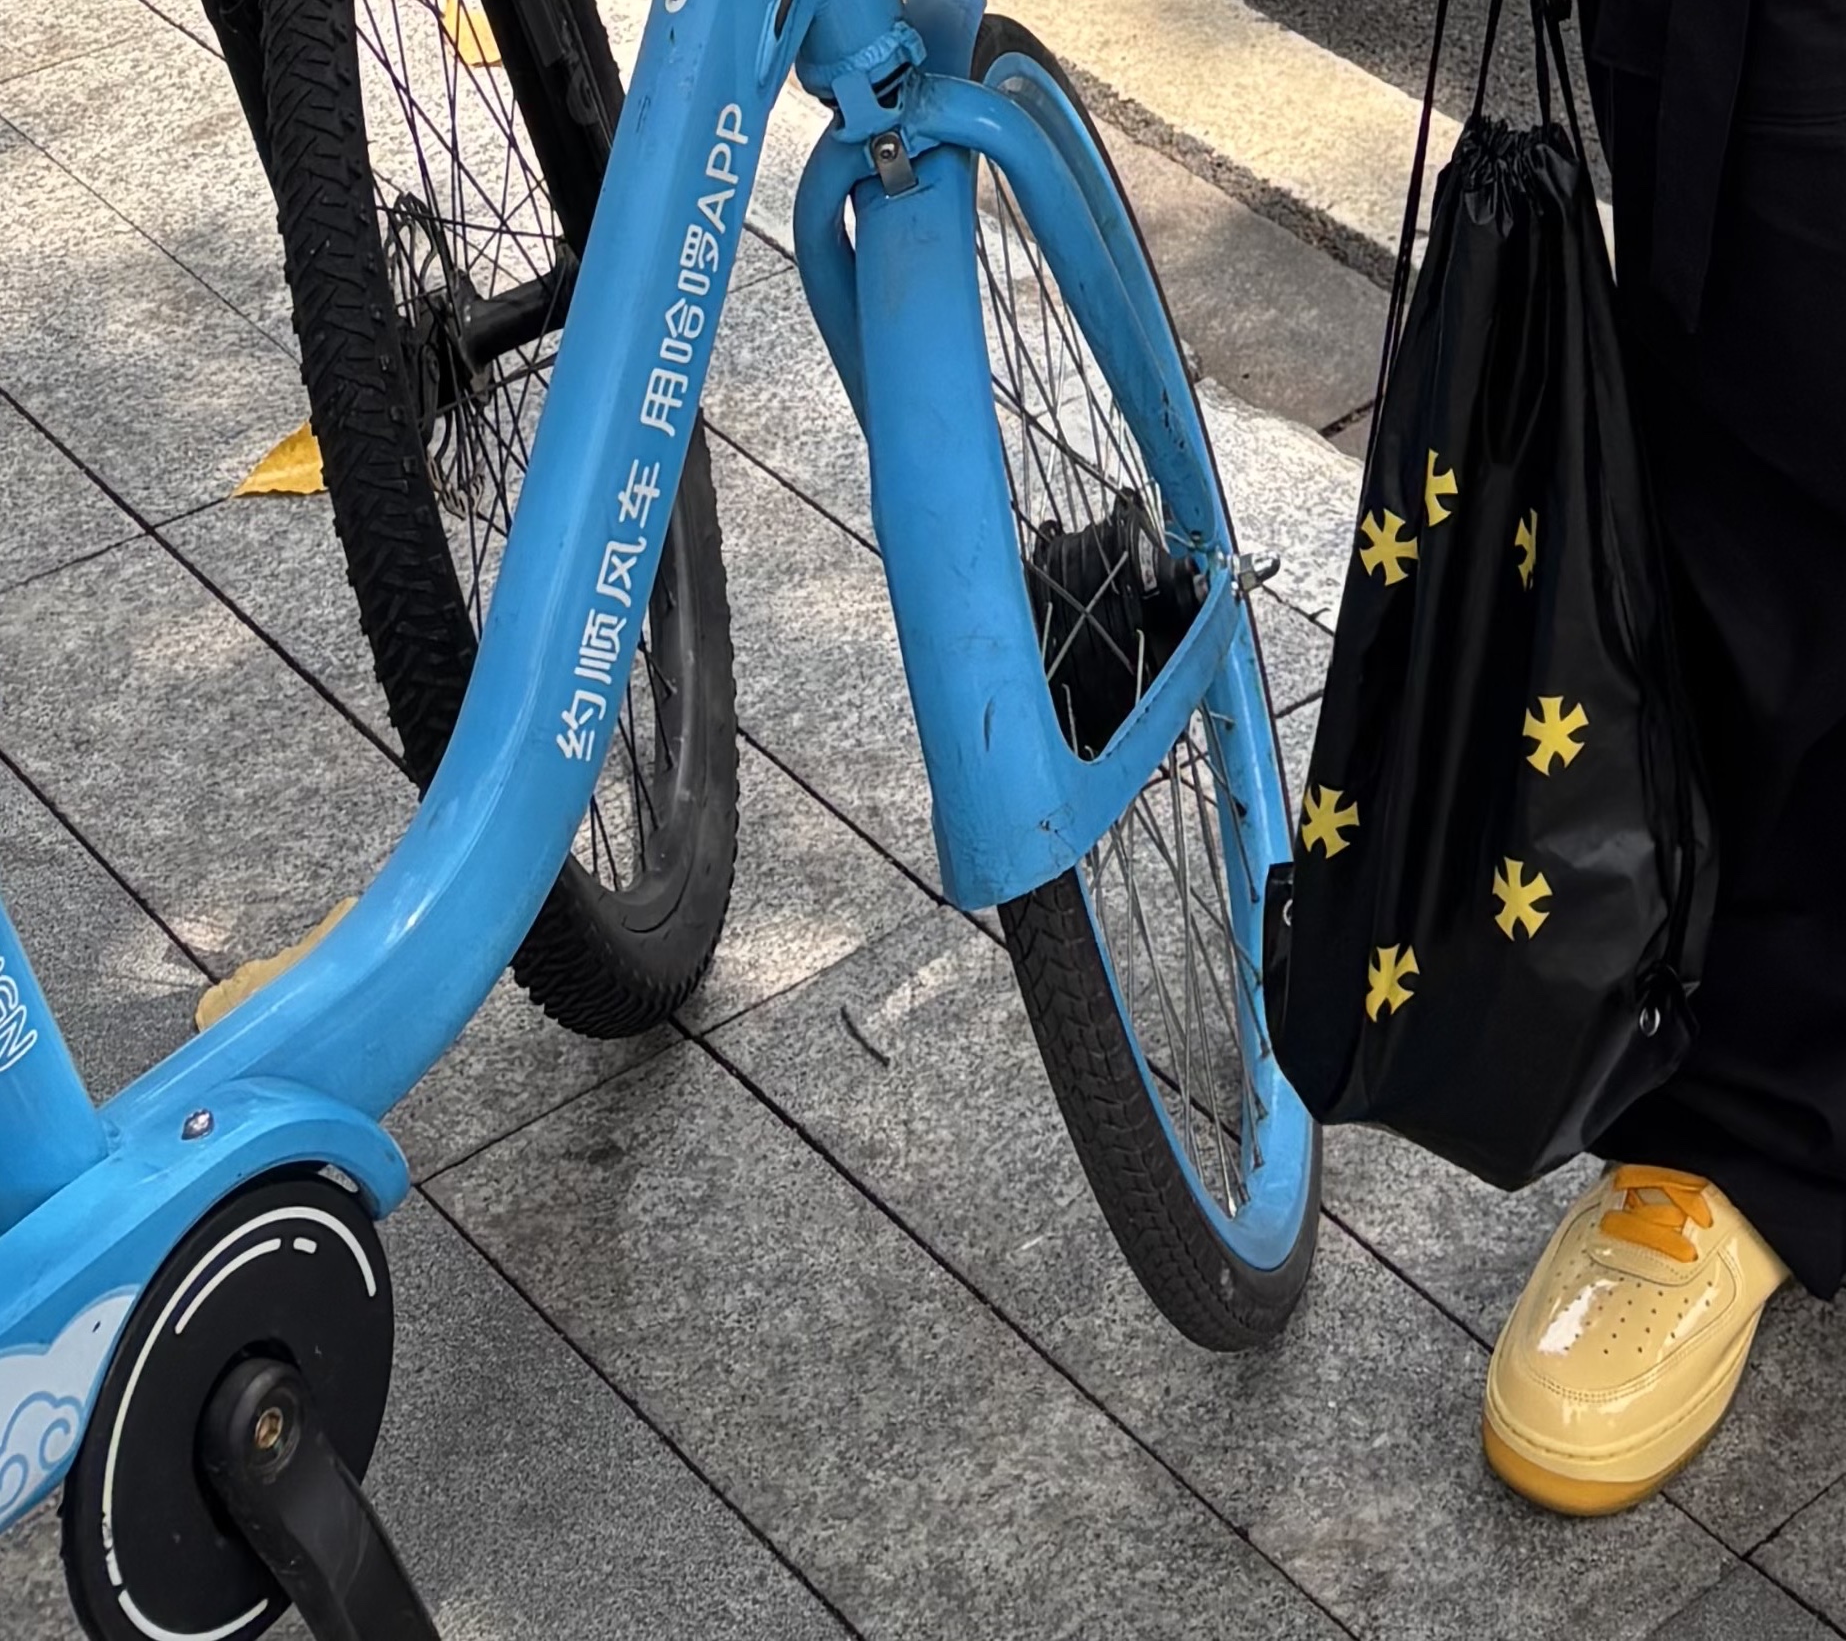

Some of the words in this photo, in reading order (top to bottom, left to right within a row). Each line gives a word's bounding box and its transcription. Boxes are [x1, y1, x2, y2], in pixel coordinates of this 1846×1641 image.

[557, 459, 660, 761] 约顺风车
[640, 103, 748, 437] 用哈啰APP
